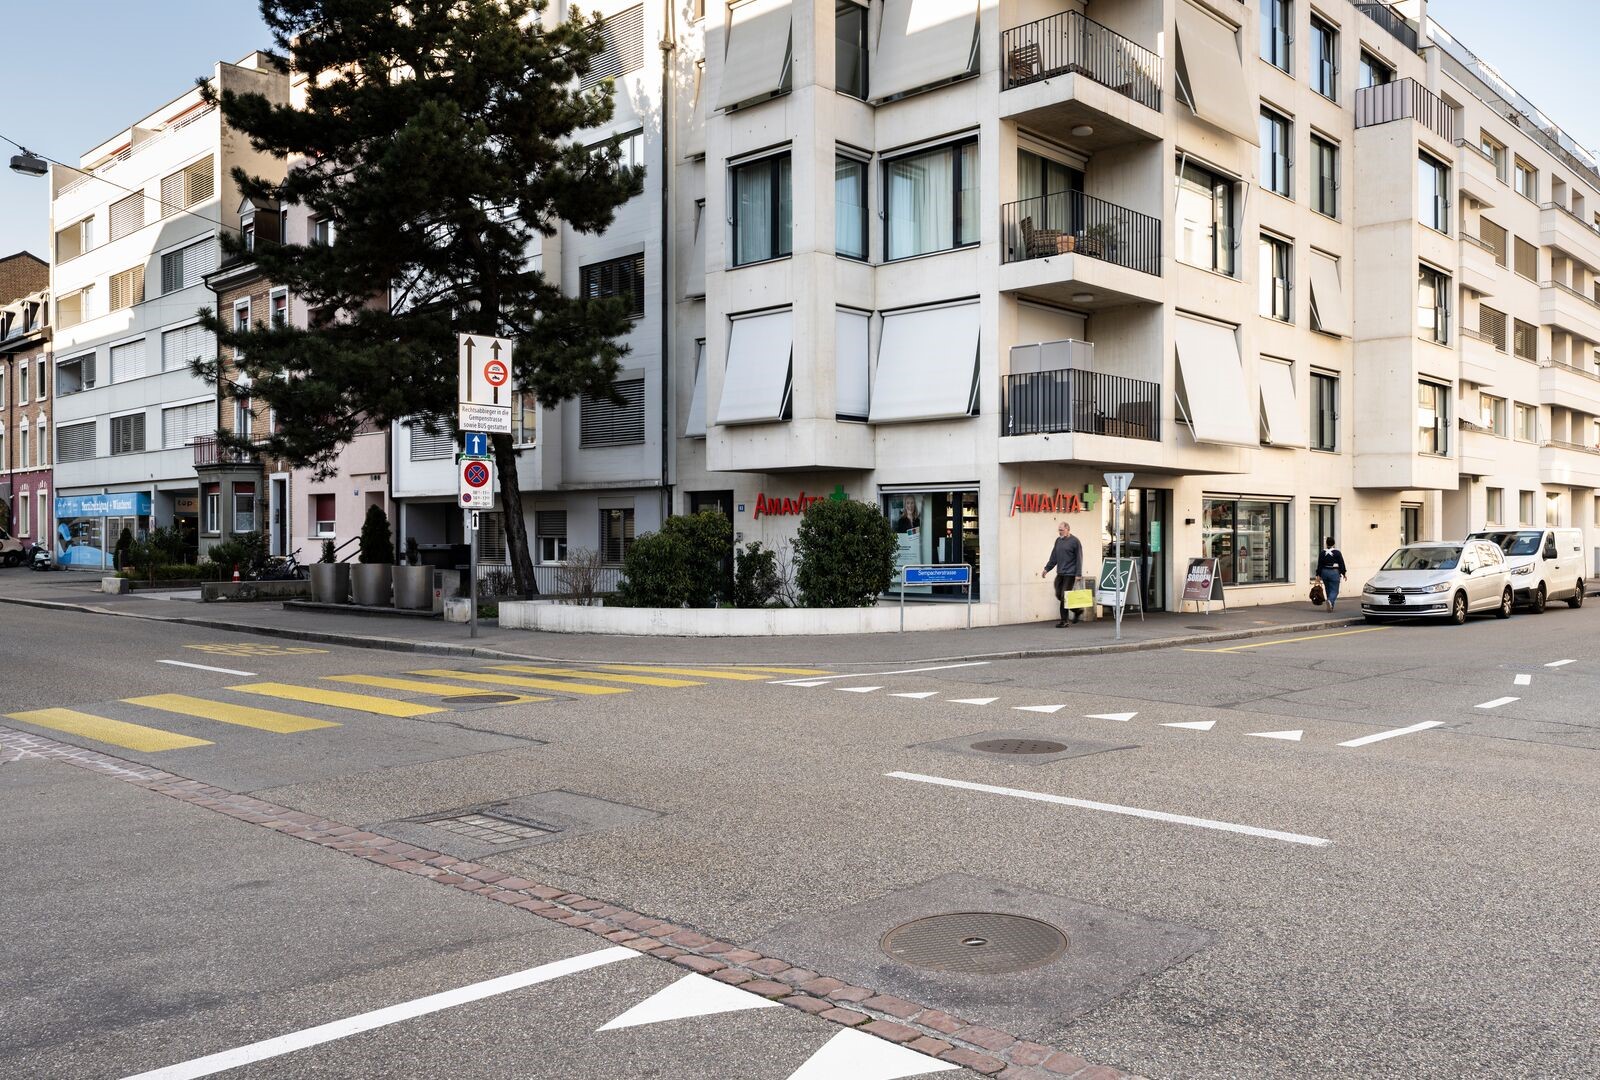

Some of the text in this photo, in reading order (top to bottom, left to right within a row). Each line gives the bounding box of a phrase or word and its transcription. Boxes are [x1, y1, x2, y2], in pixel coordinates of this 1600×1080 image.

[462, 406, 496, 416] Rechtsabbieger
[468, 414, 502, 422] Gempenstrasse
[754, 490, 824, 520] AMAVIT
[1192, 566, 1209, 574] HAUT-
